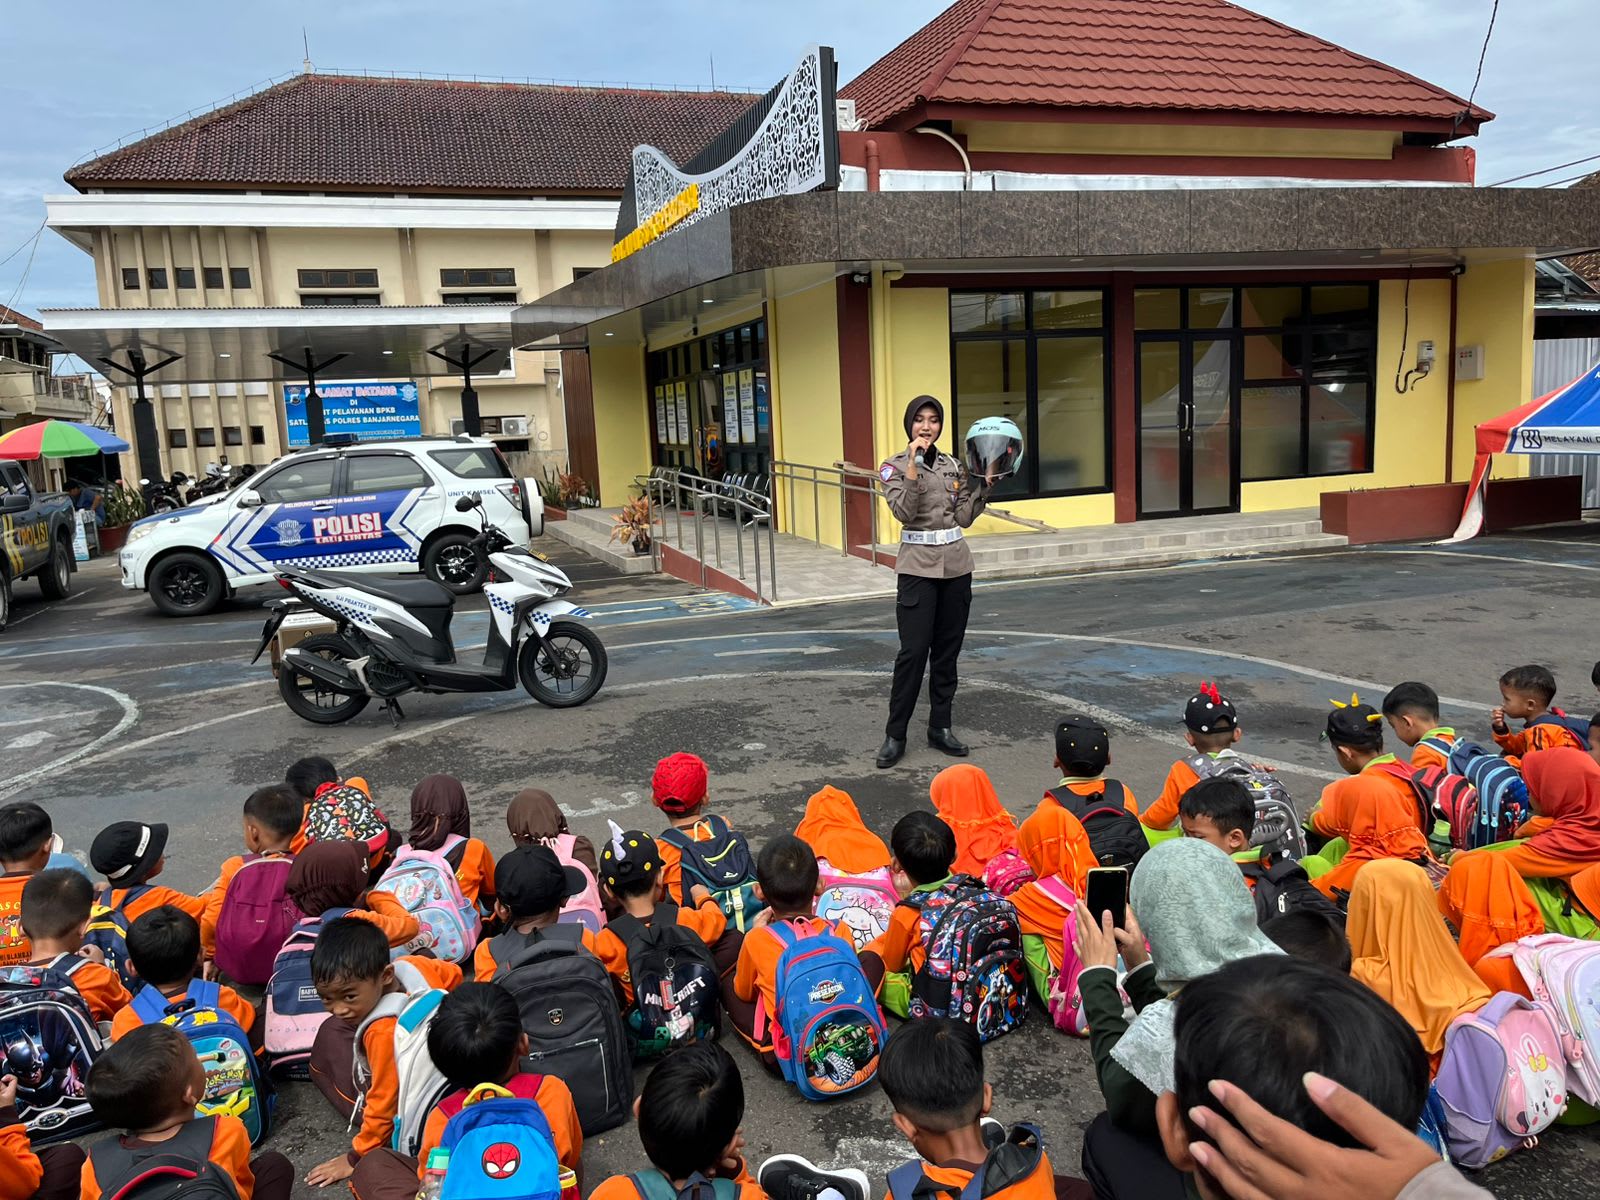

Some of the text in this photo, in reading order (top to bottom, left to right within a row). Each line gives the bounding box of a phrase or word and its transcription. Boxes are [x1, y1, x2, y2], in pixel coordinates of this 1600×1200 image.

[355, 385, 397, 397] DATANG
[332, 408, 374, 416] PELAYANAN
[333, 417, 361, 425] POLRES
[362, 415, 420, 423] BANJARNEGARA
[1543, 435, 1593, 444] MELAYANI
[312, 511, 382, 537] POLISI
